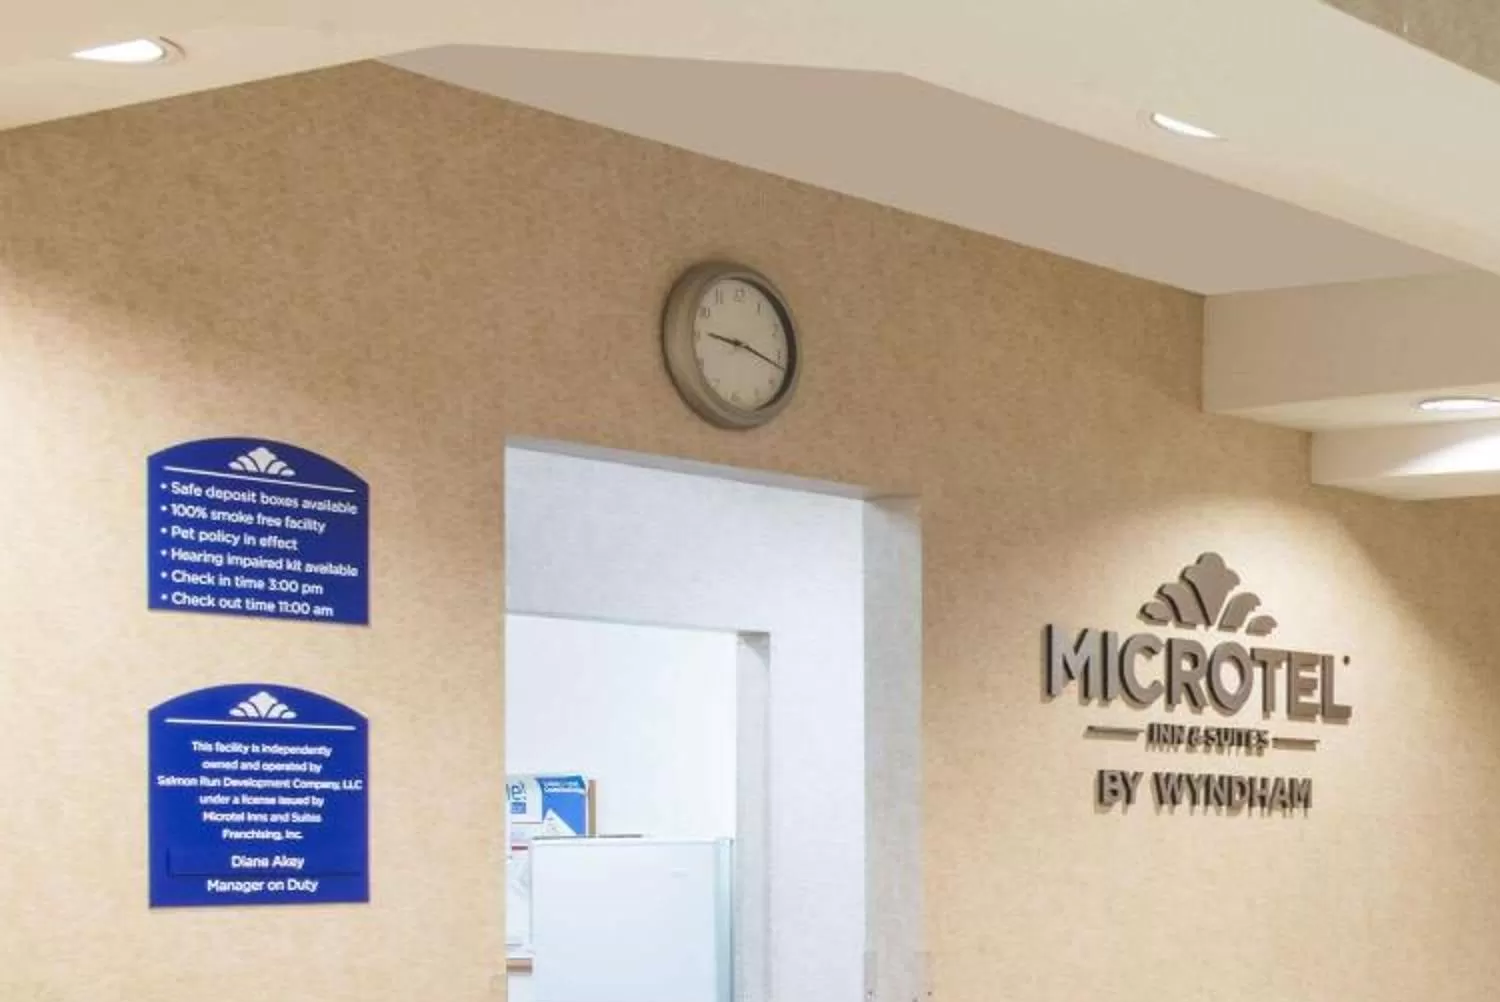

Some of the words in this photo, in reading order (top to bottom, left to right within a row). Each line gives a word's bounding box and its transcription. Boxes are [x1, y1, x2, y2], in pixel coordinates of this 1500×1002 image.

[171, 481, 202, 496] Safe
[205, 485, 256, 503] deposit
[260, 490, 298, 508] boxes
[302, 499, 357, 514] available
[171, 503, 208, 520] 100%
[210, 509, 254, 524] smoke
[257, 512, 281, 527] free
[285, 515, 326, 534] facility
[171, 526, 195, 540] Pet
[199, 529, 240, 546] policy
[244, 533, 256, 545] in
[260, 536, 298, 551] effect
[171, 548, 223, 567] Hearing
[227, 553, 282, 570] impaired
[286, 558, 302, 572] kit
[305, 560, 358, 576] available
[171, 570, 215, 585] Check
[219, 574, 231, 587] in
[235, 575, 263, 589] time
[268, 578, 298, 593] 3:00
[302, 583, 323, 595] pm
[171, 593, 215, 607] Check
[219, 596, 242, 609] out
[246, 598, 276, 612] time
[279, 602, 310, 615] 11:00
[313, 606, 333, 616] am
[1043, 623, 1352, 724] MICROTEL
[1148, 722, 1185, 746] INN
[1204, 727, 1269, 749] SUITES
[192, 741, 212, 752] This
[215, 742, 248, 754] facility
[251, 744, 259, 753] is
[262, 744, 332, 757] independently
[202, 760, 238, 770] owned
[240, 761, 260, 771] and
[262, 763, 306, 773] operated
[310, 762, 321, 773] by
[157, 776, 197, 786] Salmon
[200, 776, 220, 786] Run
[224, 777, 290, 790] Development
[342, 780, 362, 789] LLC
[1097, 770, 1143, 806] BY
[1153, 772, 1313, 809] WYNDHAM
[199, 795, 230, 804] under
[242, 796, 276, 805] license
[278, 796, 310, 806] issued
[312, 796, 324, 807] by
[203, 812, 244, 822] Microtel
[271, 813, 289, 822] and
[291, 813, 321, 822] Suites
[285, 830, 303, 839] Inc.
[207, 879, 264, 893] Manager
[268, 880, 284, 891] on
[288, 878, 319, 892] Duty
